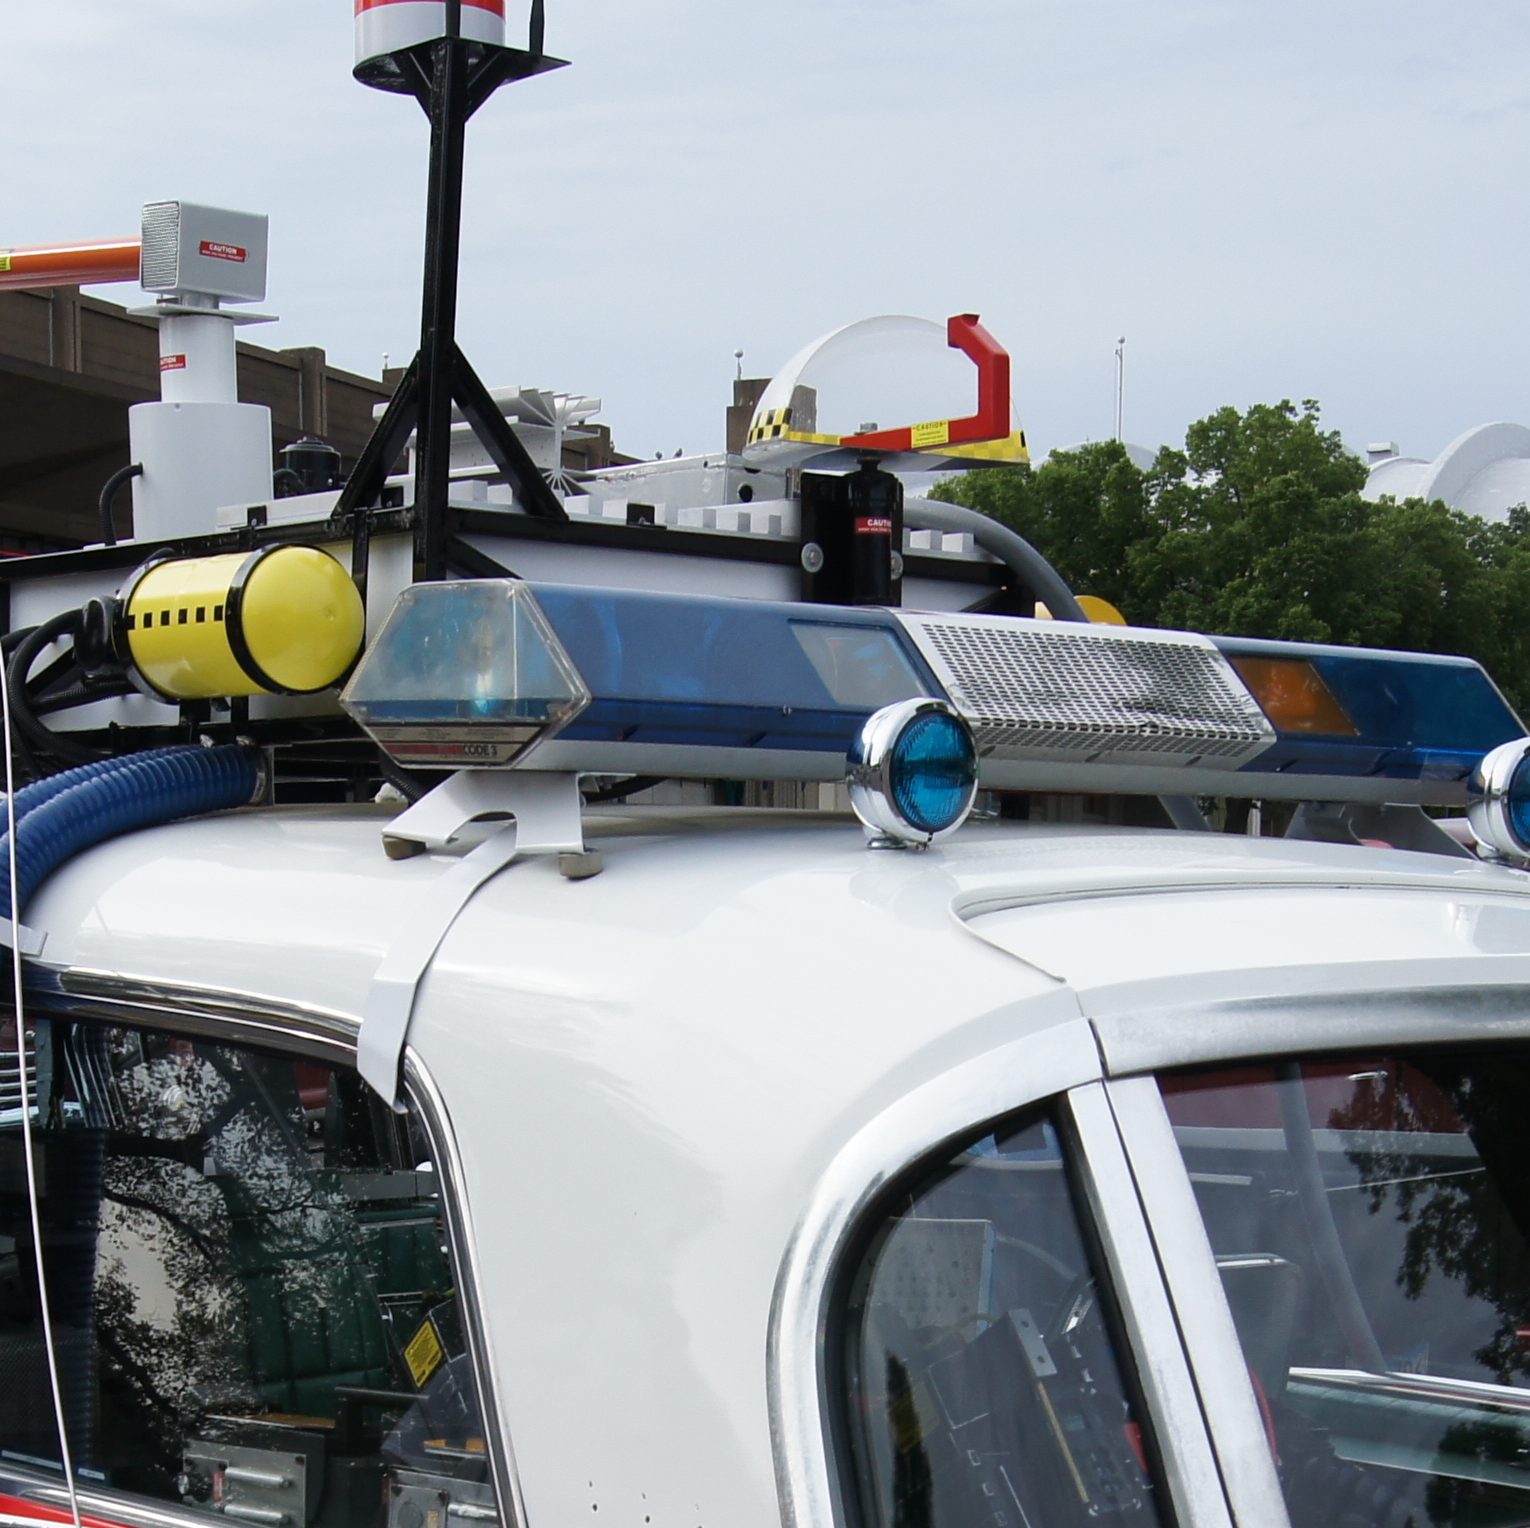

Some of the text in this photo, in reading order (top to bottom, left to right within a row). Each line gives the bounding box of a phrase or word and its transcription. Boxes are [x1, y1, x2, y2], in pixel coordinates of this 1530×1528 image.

[209, 243, 237, 254] CAUTION
[916, 421, 943, 430] CAUTION
[463, 743, 489, 756] CODE
[491, 744, 498, 757] 3
